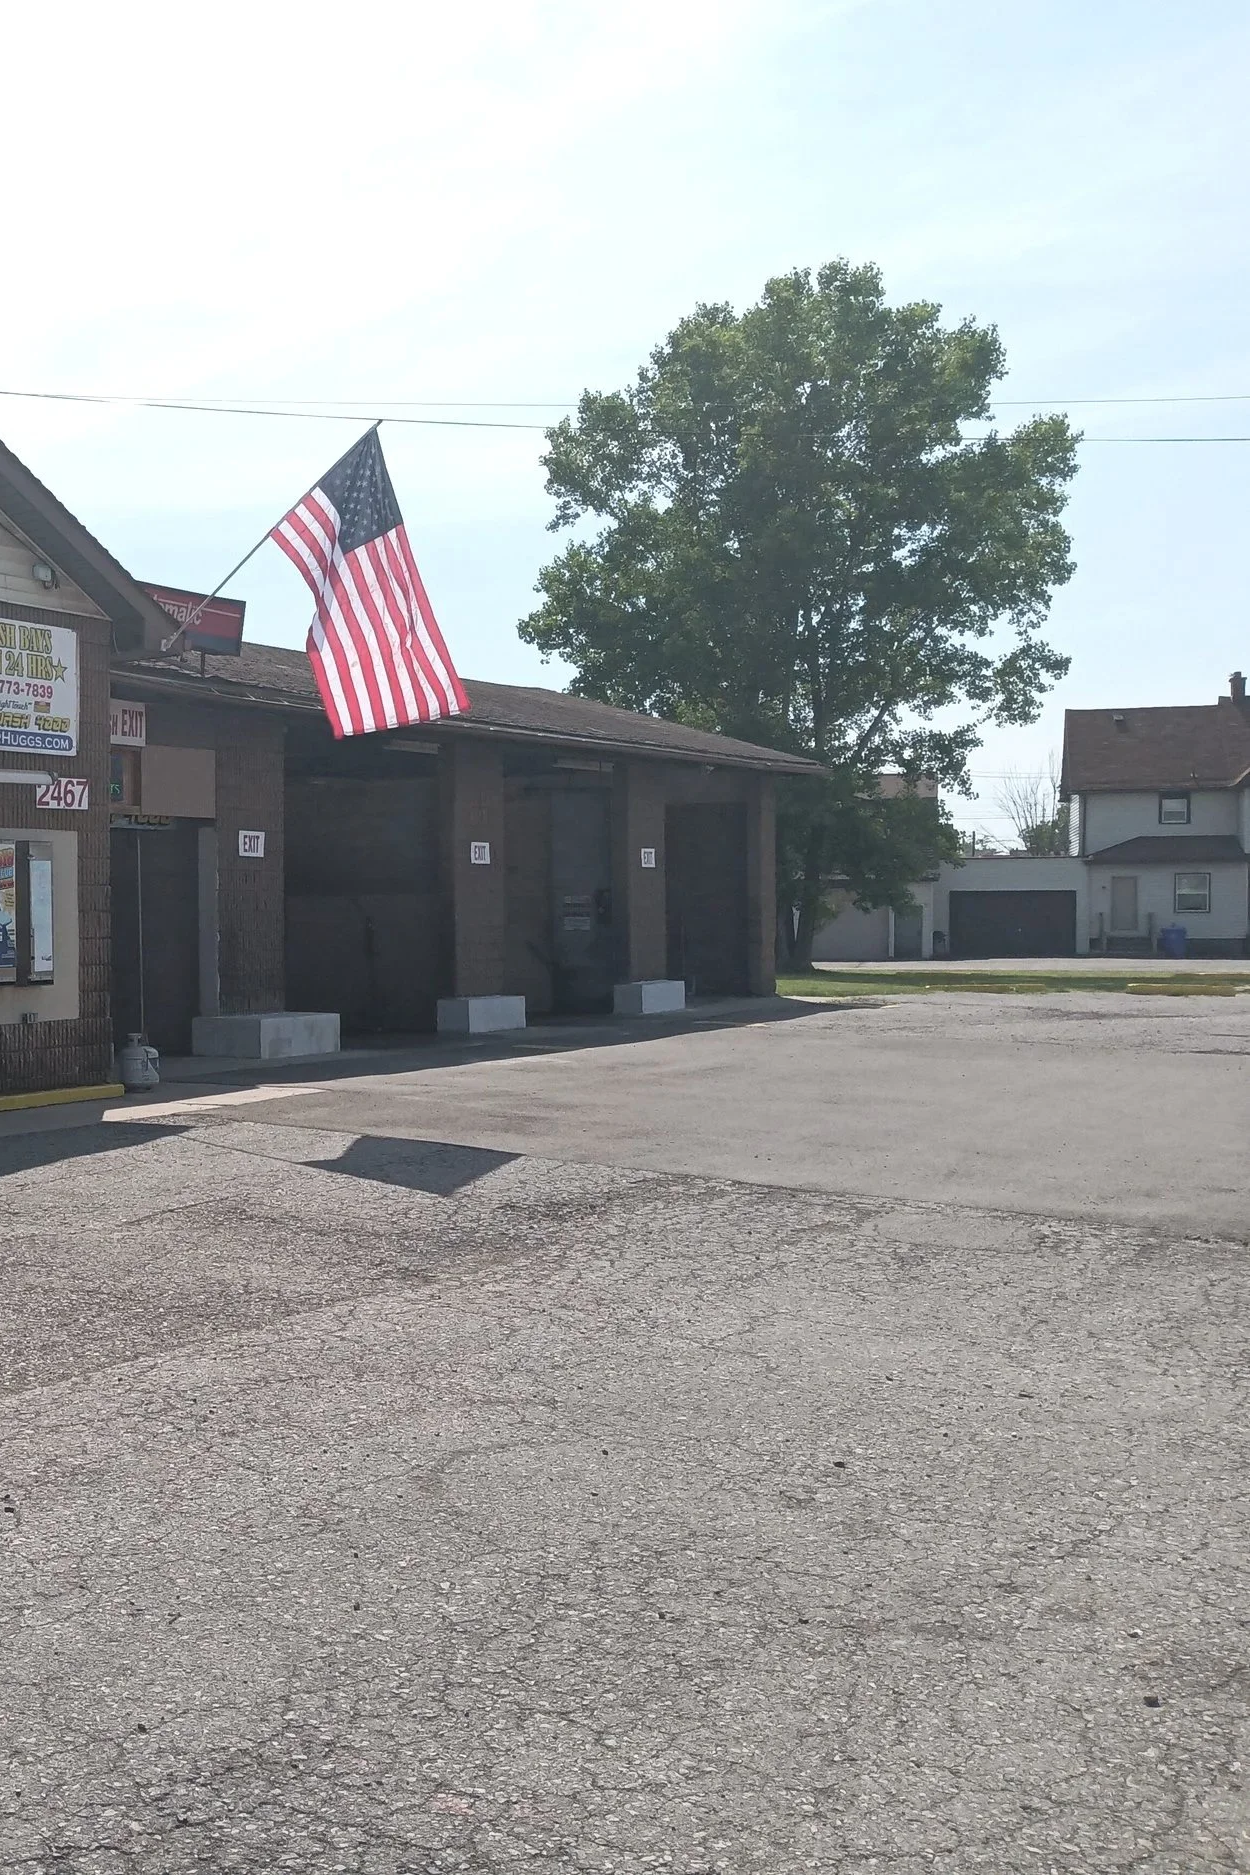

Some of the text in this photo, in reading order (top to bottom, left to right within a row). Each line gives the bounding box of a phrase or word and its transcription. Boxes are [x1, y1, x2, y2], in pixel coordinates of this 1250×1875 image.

[19, 625, 52, 654] BAYS
[5, 651, 24, 677] 24
[27, 653, 53, 680] HRS
[0, 680, 53, 699] 773-7839
[34, 715, 70, 733] 4000
[121, 708, 143, 738] EXIT
[37, 779, 88, 807] 2467
[243, 835, 260, 853] EXIT
[474, 845, 486, 861] EXIT
